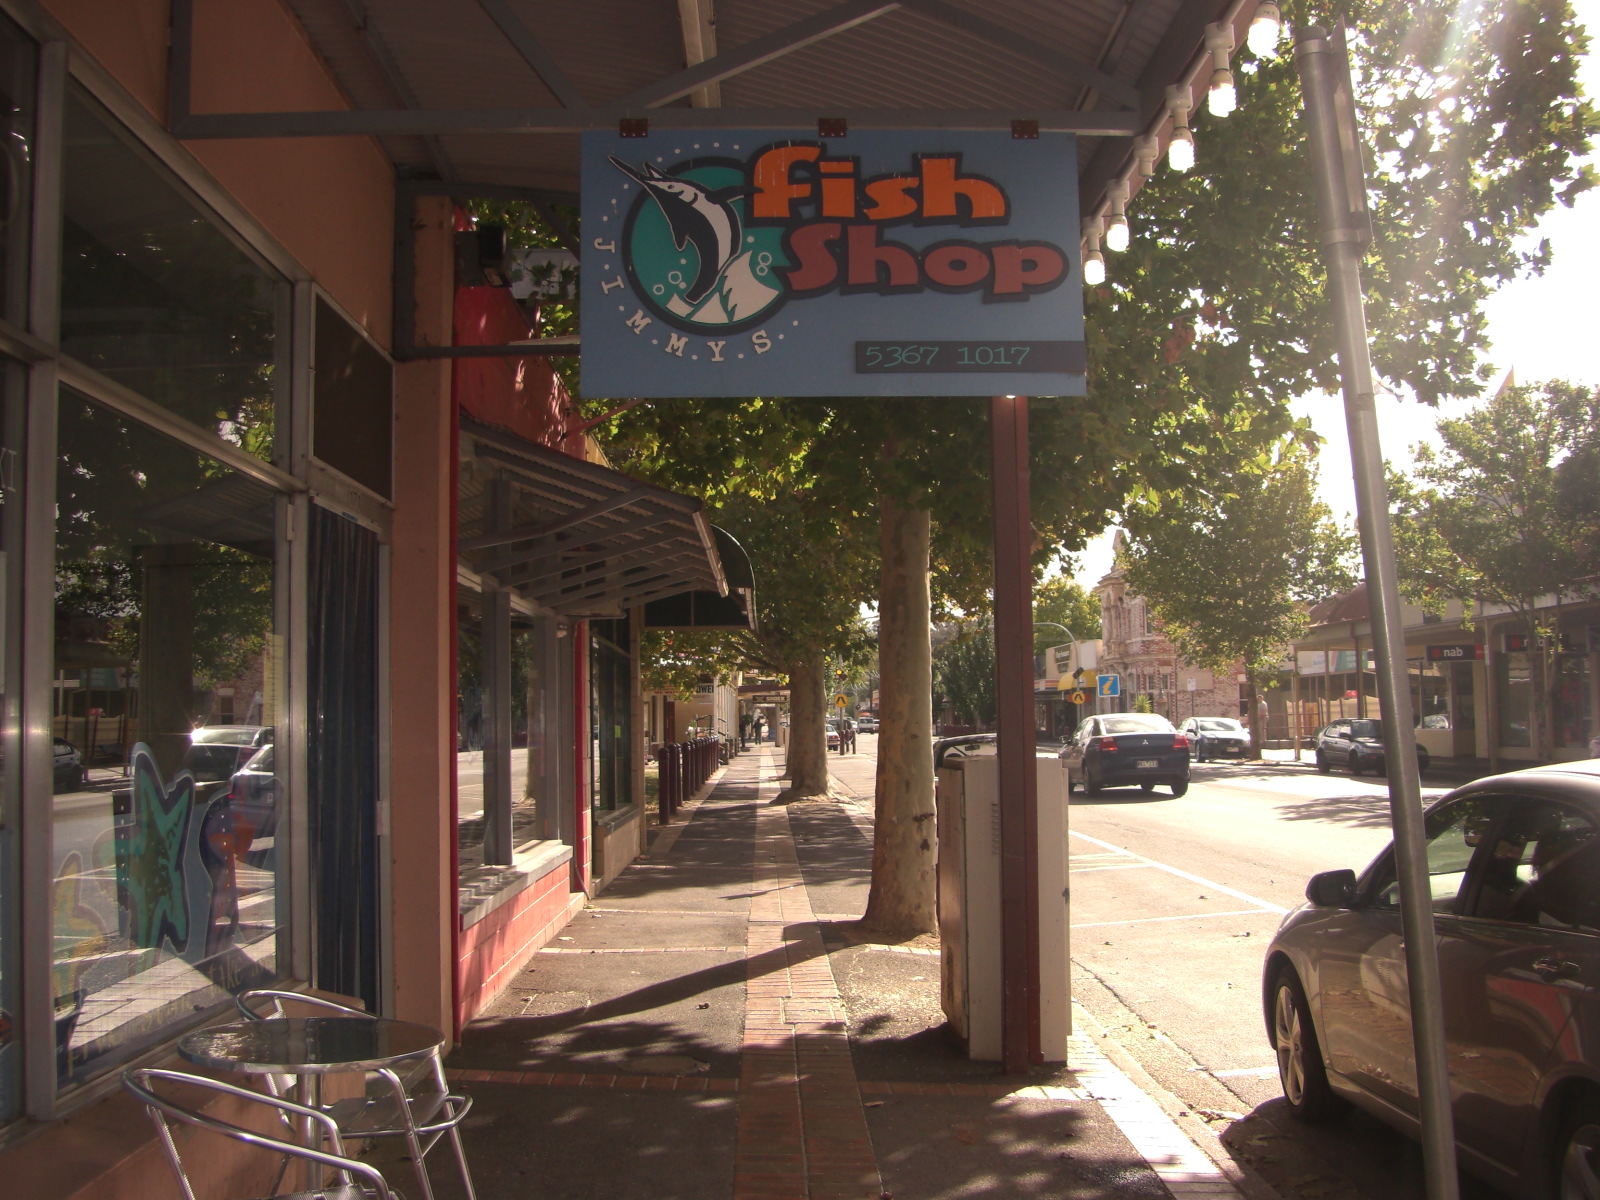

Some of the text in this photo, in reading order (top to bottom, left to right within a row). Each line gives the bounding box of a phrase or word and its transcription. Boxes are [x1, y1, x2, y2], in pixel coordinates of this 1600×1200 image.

[752, 143, 1008, 219] fish
[786, 223, 1065, 295] Shop
[865, 345, 1031, 366] 5367 1017
[1443, 646, 1463, 657] nab
